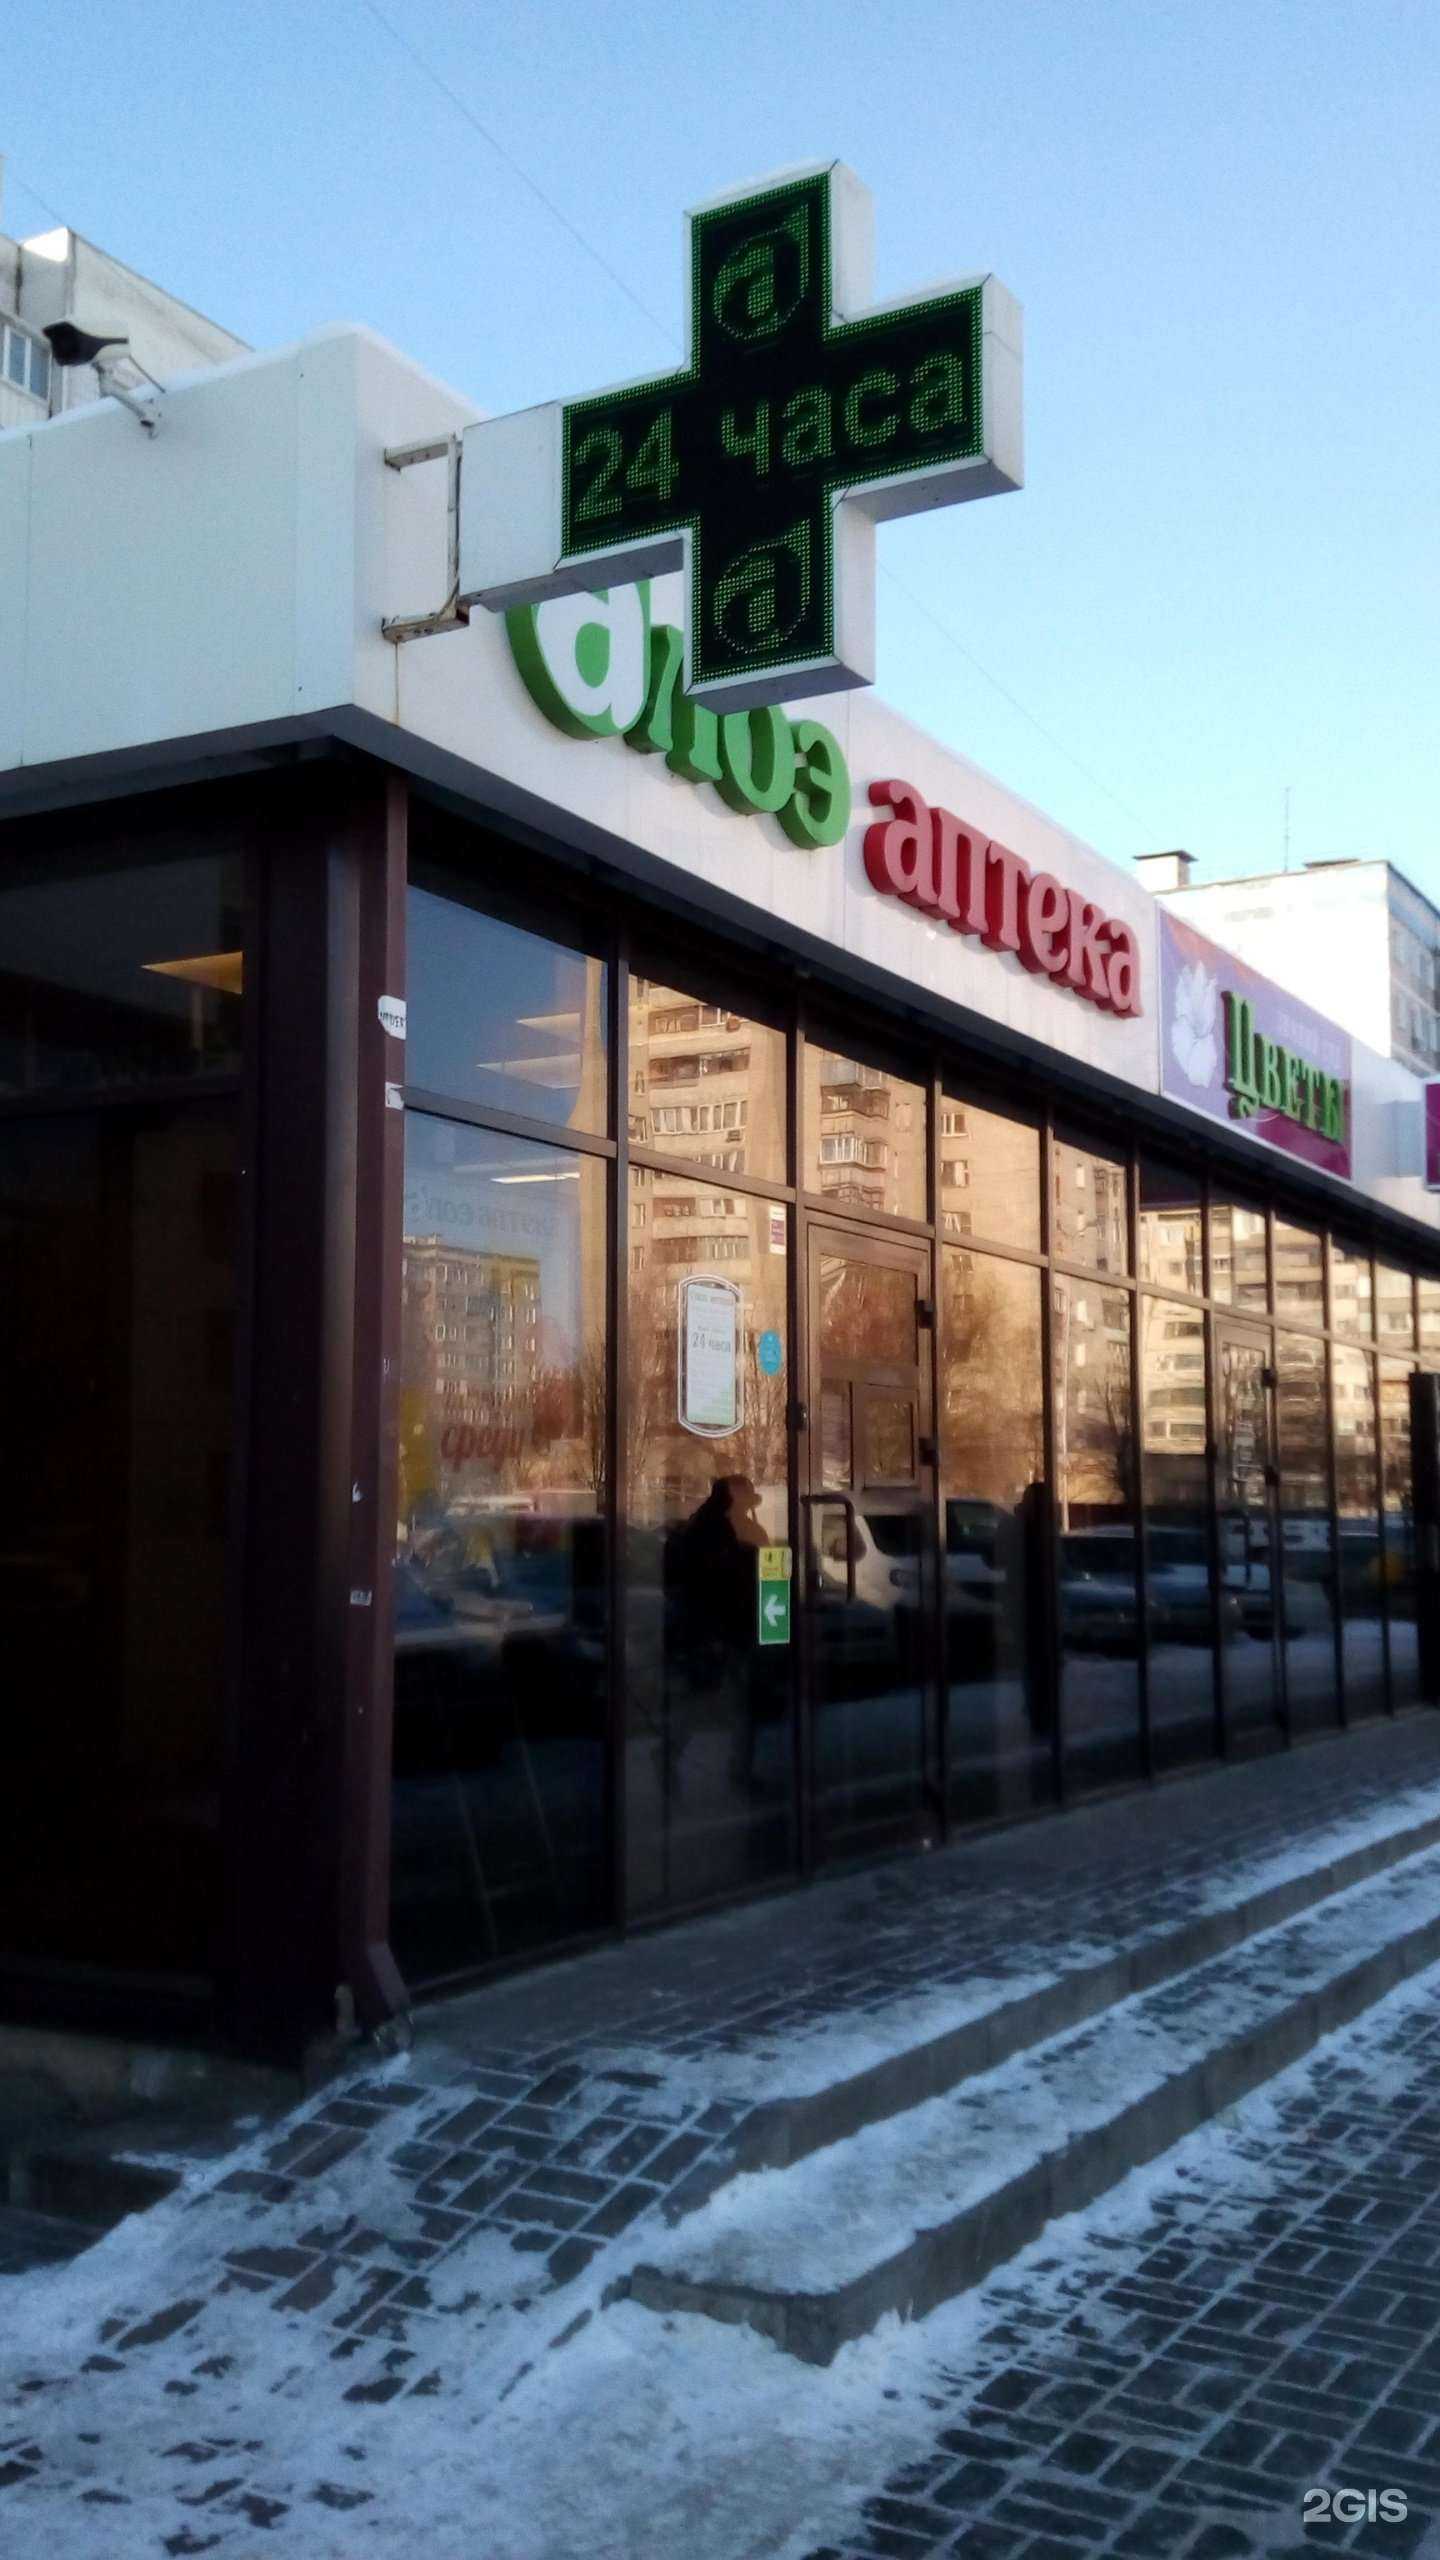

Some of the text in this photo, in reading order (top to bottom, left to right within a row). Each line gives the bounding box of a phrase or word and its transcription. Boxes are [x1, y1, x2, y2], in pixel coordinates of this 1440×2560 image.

[574, 351, 968, 524] 24 часа
[864, 779, 1143, 1018] аптека
